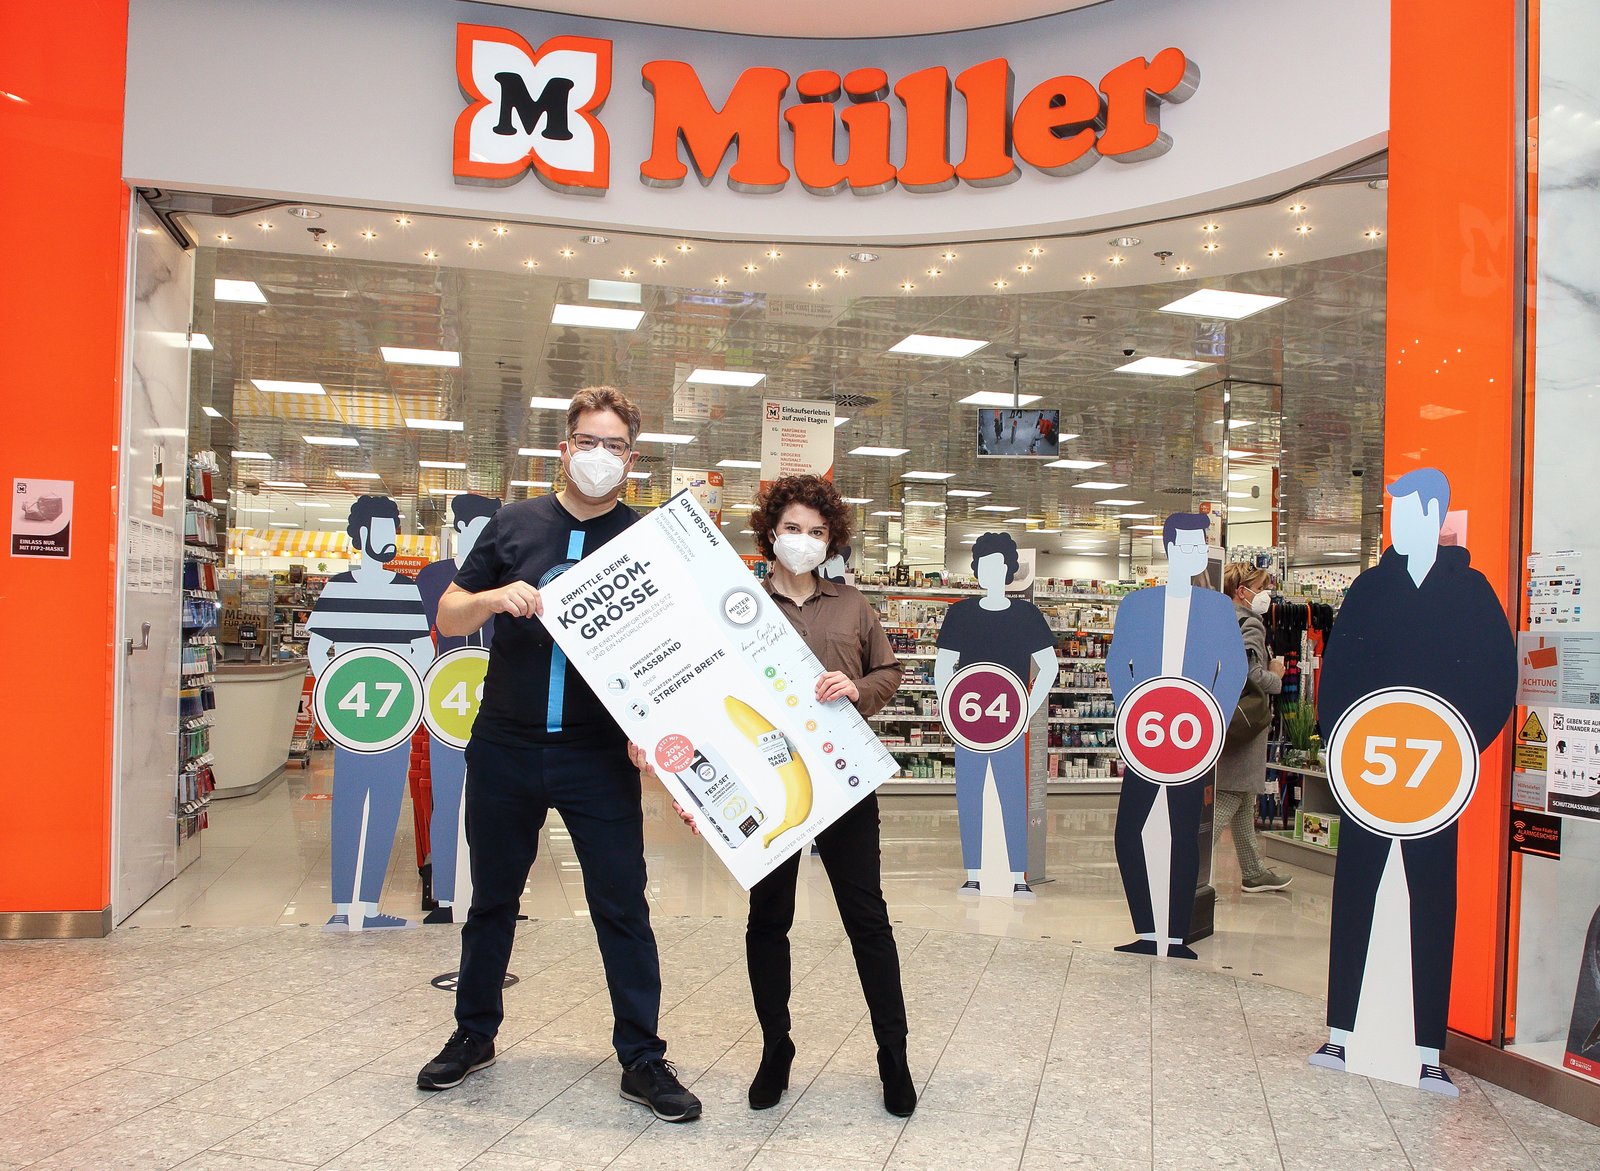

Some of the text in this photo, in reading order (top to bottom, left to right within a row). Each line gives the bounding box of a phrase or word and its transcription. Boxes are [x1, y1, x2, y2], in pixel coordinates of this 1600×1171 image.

[492, 72, 574, 141] M
[640, 47, 1190, 190] Müller
[782, 406, 831, 416] Einkaufserlebnis
[808, 416, 828, 425] Etagen
[680, 498, 719, 546] MASSBAND
[557, 561, 651, 630] KONDOM-
[561, 554, 630, 605] ERMITTLE DEINE
[580, 579, 658, 639] GRÖSSE
[729, 597, 750, 614] MISTER
[736, 604, 750, 616] SIZE
[586, 593, 672, 656] FÜR EINEN KOMFORTABLEN SITZ
[592, 601, 675, 661] UND EIN NATÜRLICHES GEFÜHL
[629, 638, 672, 671] ABMESSEN MIT DEM
[634, 641, 682, 678] MASSBAND
[648, 664, 692, 696] SCHÄTZEN ANHAND
[653, 648, 726, 704] STREIFEN BREITE
[1522, 679, 1557, 687] ACHTUNG
[338, 682, 402, 718] 47
[958, 692, 1011, 723] 64
[1136, 711, 1202, 750] 60
[664, 746, 690, 768] RABATT
[768, 752, 787, 763] MASS-
[1360, 736, 1443, 788] 57
[705, 774, 730, 796] TEST-SET
[1518, 829, 1558, 840] ALARMGESICHERT
